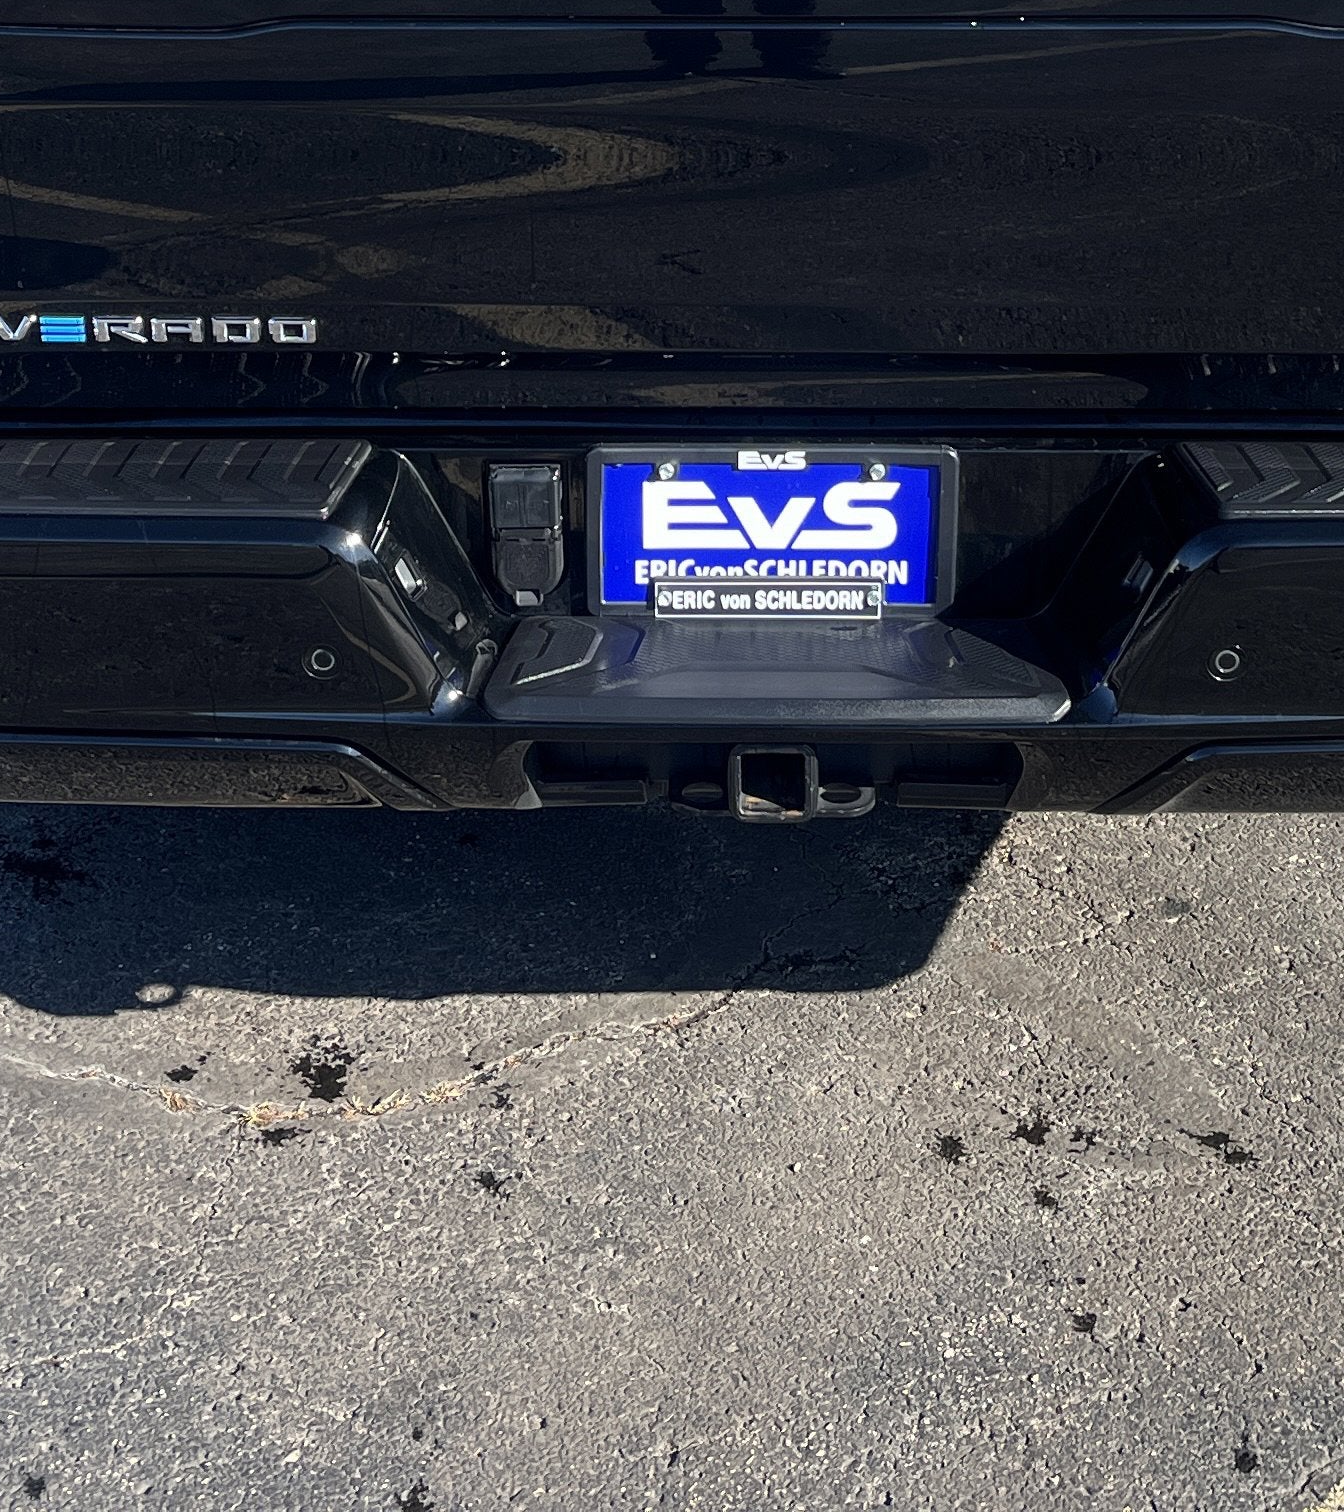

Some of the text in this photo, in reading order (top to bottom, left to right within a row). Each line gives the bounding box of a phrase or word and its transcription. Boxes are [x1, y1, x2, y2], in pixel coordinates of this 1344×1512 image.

[672, 590, 864, 610] ERIC von SCHLEDORN
